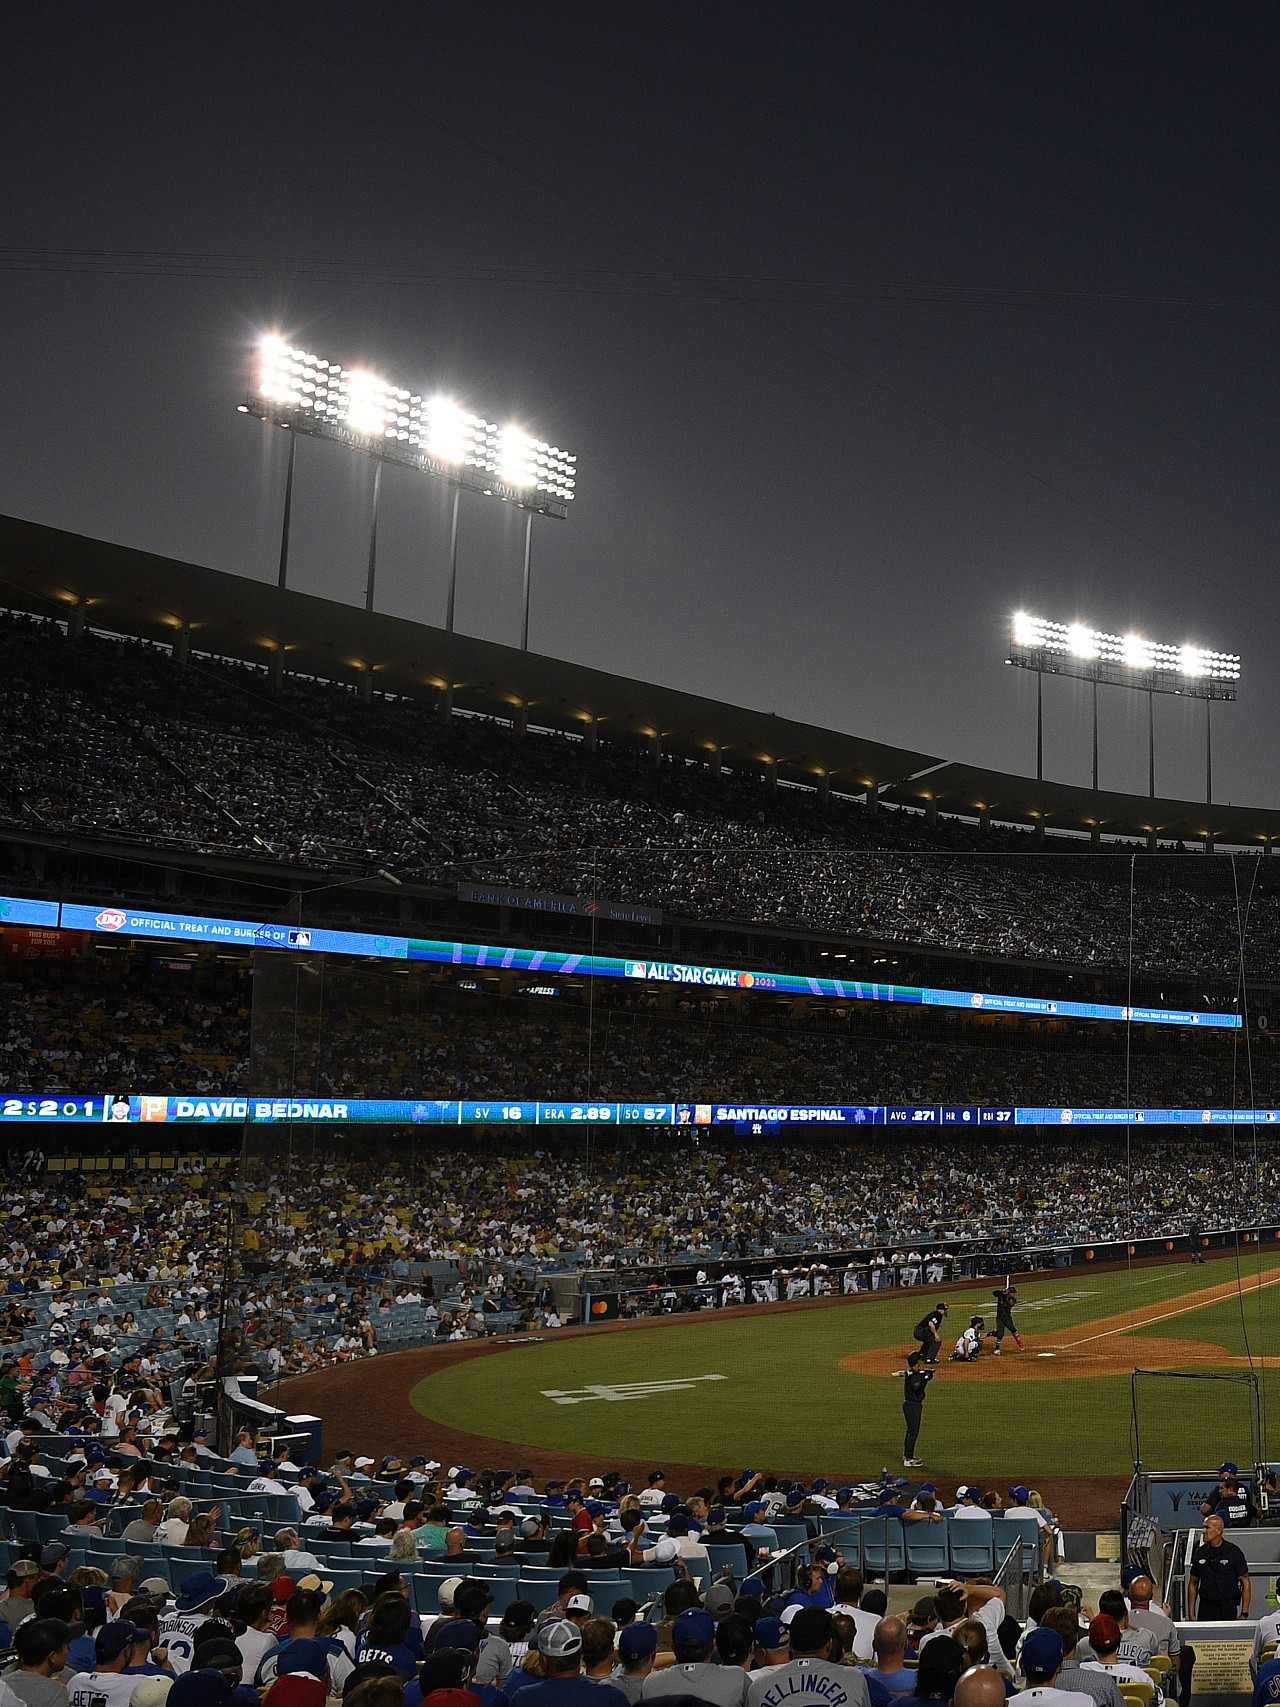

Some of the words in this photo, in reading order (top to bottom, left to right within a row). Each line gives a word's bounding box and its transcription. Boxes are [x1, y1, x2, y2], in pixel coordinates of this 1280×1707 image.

[472, 891, 504, 904] BANK
[508, 895, 522, 906] OF
[525, 897, 577, 914] AMERICA
[101, 913, 123, 926] DQ
[130, 917, 176, 931] OFFICIAL
[179, 922, 209, 934] TREAT
[211, 926, 231, 936] AND
[234, 927, 271, 940] BURGER
[273, 931, 286, 941] OF
[648, 963, 670, 980] ALL
[673, 965, 701, 984] STAR
[703, 968, 737, 987] GAME
[755, 978, 777, 988] 2022
[4, 1100, 23, 1116] 2
[27, 1101, 36, 1116] S
[39, 1101, 58, 1117] 2
[84, 1101, 94, 1117] 1
[177, 1102, 248, 1118] DAVID
[255, 1104, 348, 1119] BEDNAR
[475, 1107, 489, 1119] SV
[502, 1107, 522, 1120] 16
[545, 1108, 565, 1120] ERA
[570, 1107, 611, 1120] 2.89
[625, 1109, 640, 1120] SO
[644, 1107, 667, 1120] 57
[717, 1108, 788, 1121] SANTIAGO
[790, 1109, 846, 1122] ESPINAL
[890, 1111, 907, 1121] AVG
[911, 1110, 935, 1122] .271
[946, 1111, 956, 1121] HR
[962, 1111, 971, 1122] 6
[983, 1112, 994, 1121] RBI
[997, 1111, 1012, 1122] 37
[359, 1648, 394, 1664] BETTS
